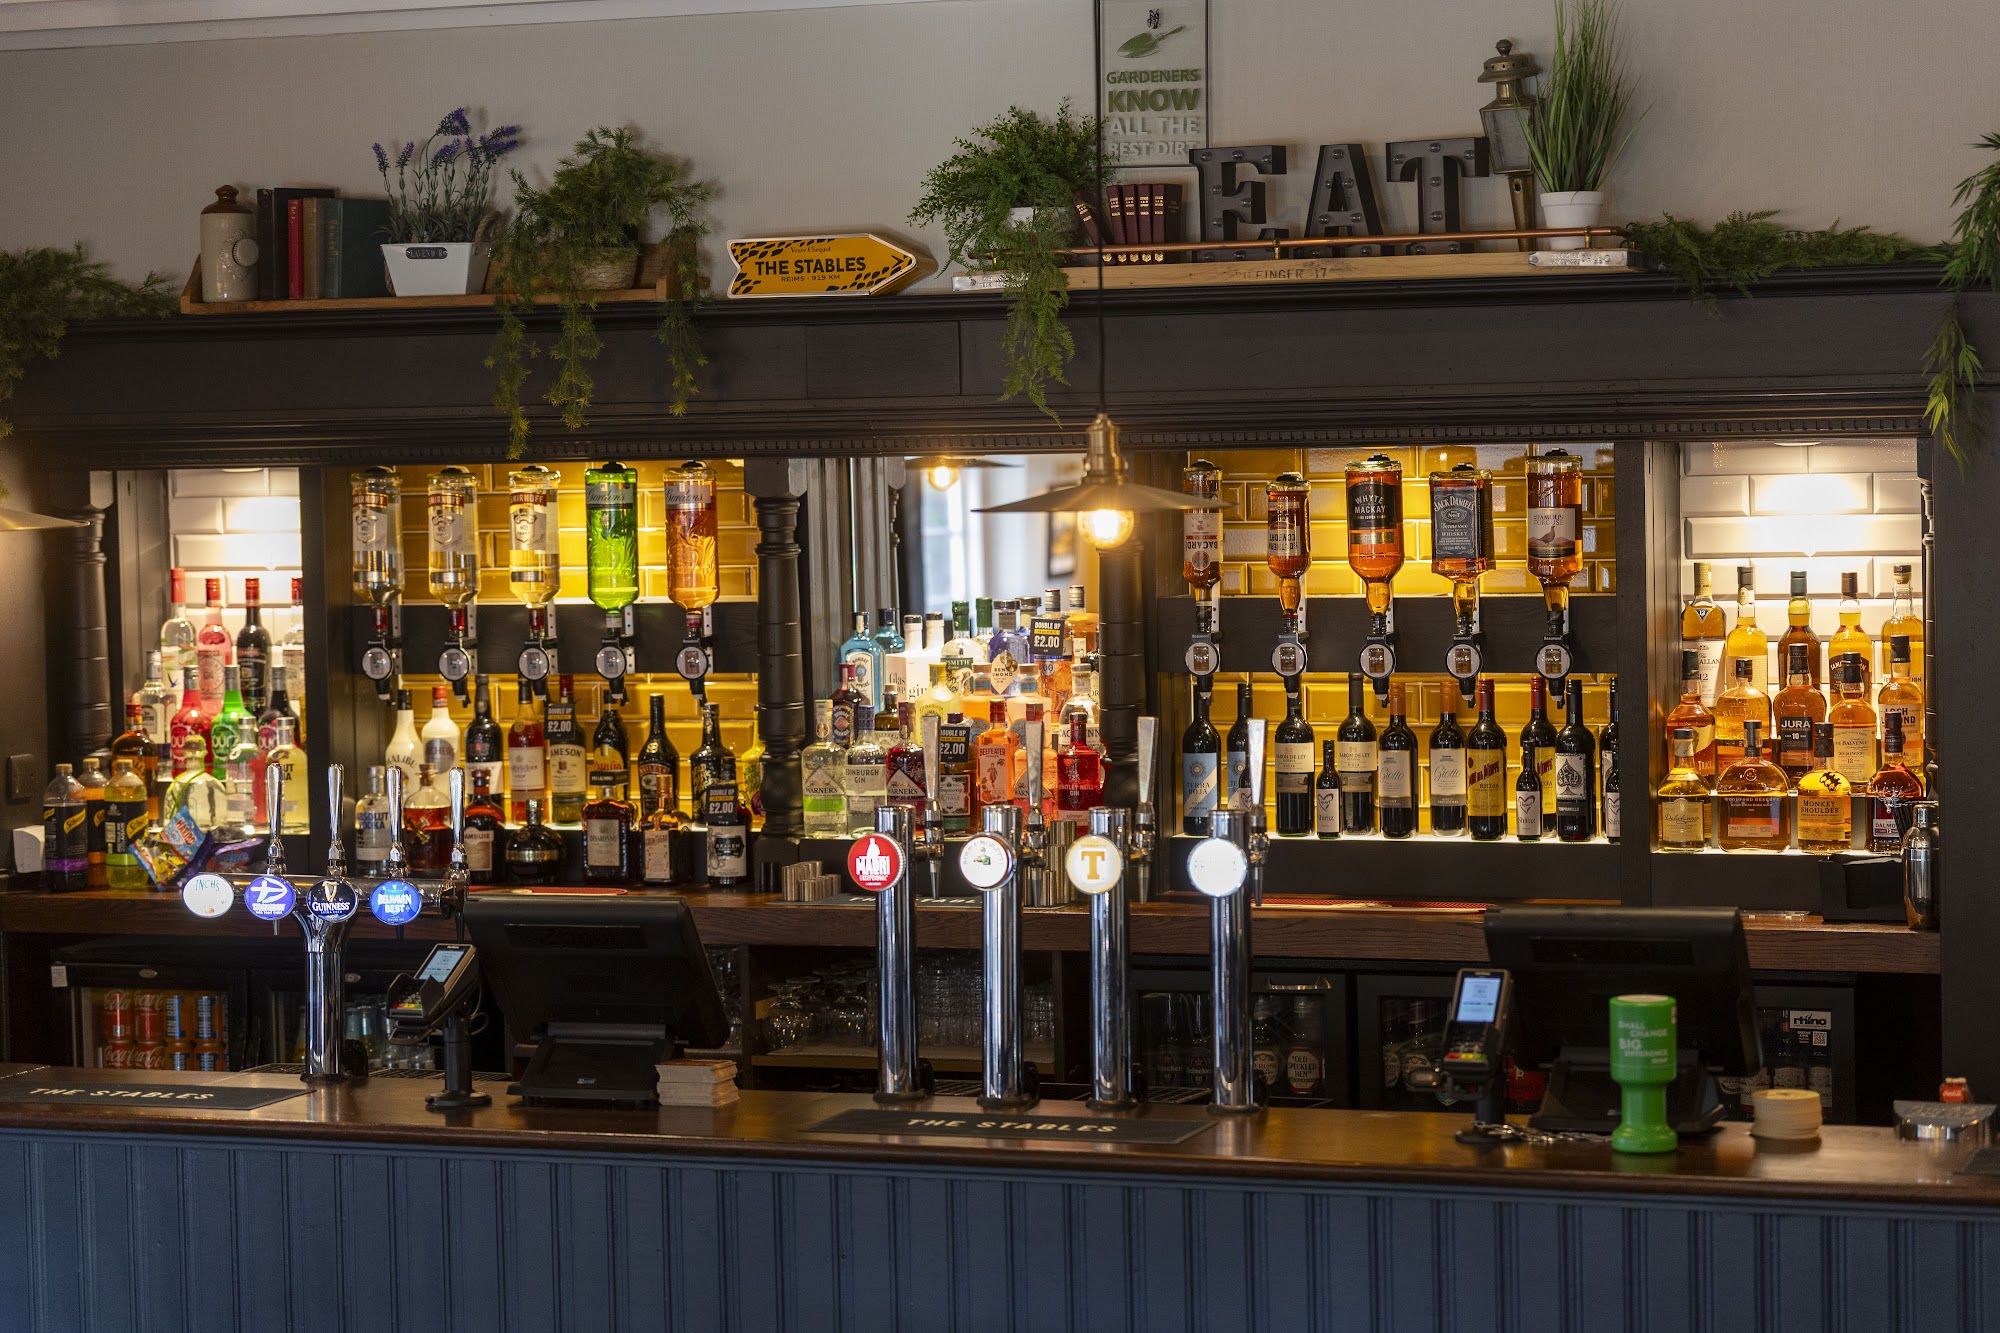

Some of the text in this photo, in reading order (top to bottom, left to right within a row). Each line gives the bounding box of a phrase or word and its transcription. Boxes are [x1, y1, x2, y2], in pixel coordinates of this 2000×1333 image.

[1106, 69, 1199, 84] GARDENERS
[1108, 88, 1199, 113] KNOW
[1109, 116, 1199, 135] ALL THE
[1107, 141, 1151, 157] BEST
[1189, 137, 1490, 264] EAT
[755, 256, 867, 276] THE STABLES
[812, 274, 826, 282] 919
[829, 273, 841, 281] KM
[510, 493, 544, 504] SMIRNOFF
[1355, 495, 1384, 505] WHYTE
[1434, 495, 1477, 512] JACK DANIEL'S
[1354, 506, 1386, 514] MACKAY
[1034, 621, 1061, 631] DOUBLE UP
[1033, 634, 1060, 649] £2.00
[547, 721, 571, 732] £2.00
[1781, 719, 1812, 729] JURA
[959, 729, 967, 737] UP
[1791, 732, 1800, 740] 10
[979, 748, 1006, 756] BEEFEATER
[386, 754, 418, 768] MALIBU
[1433, 765, 1462, 781] Giotto
[709, 789, 727, 797] DOUBLE
[709, 802, 734, 815] £2.00
[1803, 799, 1836, 807] MONKEY
[175, 816, 198, 847] HARIBO
[1081, 850, 1105, 880] T
[312, 901, 351, 912] GUINNESS
[384, 904, 406, 914] BEST
[1793, 1013, 1827, 1026] rhino
[1618, 1038, 1643, 1050] BIG
[29, 1087, 216, 1102] THE STABLES
[906, 1117, 1119, 1134] THE STABLES
